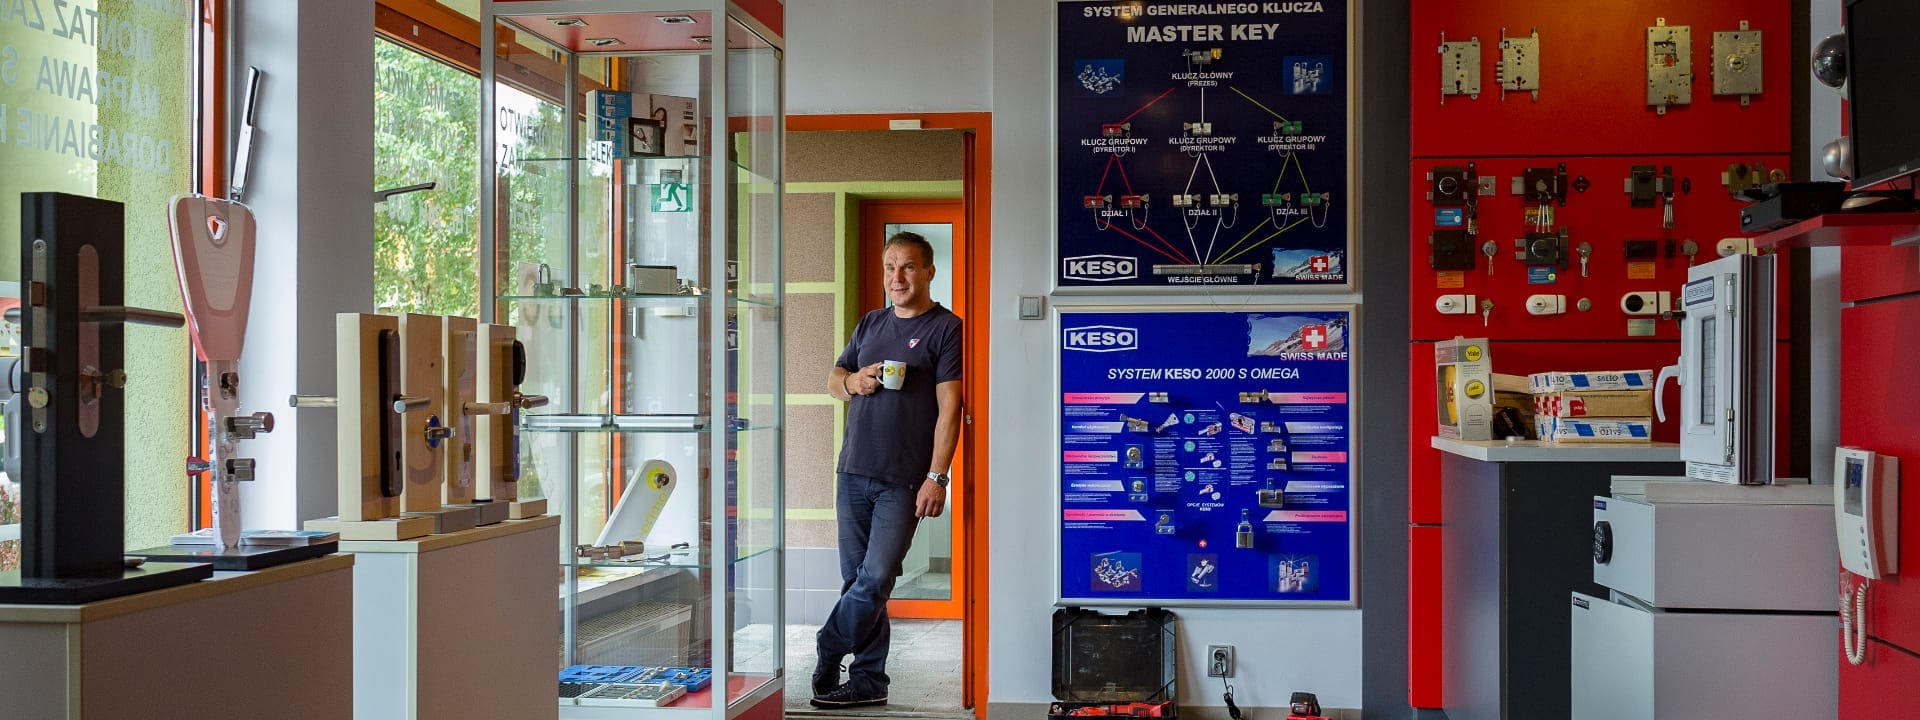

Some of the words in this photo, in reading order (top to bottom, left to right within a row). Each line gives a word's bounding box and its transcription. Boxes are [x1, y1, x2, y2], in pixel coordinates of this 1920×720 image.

[1083, 5, 1143, 17] SYSTEM
[1147, 3, 1259, 16] GENERALNEGO
[1262, 2, 1323, 14] KLUCZA
[1127, 25, 1223, 43] MASTER
[1231, 23, 1279, 41] KEY
[1171, 72, 1197, 80] KLUCZ
[1198, 71, 1233, 80] GŁÓWNY
[1187, 80, 1218, 88] (PREZES)
[1081, 138, 1107, 147] KLUCZ
[1108, 138, 1148, 146] GRUPOWY
[1168, 137, 1195, 145] KLUCZ
[1257, 136, 1283, 144] KLUCZ
[1285, 135, 1326, 143] GRUPOWY
[1069, 260, 1133, 276] KESO
[1167, 275, 1202, 284] WEJŚCIE
[1204, 275, 1238, 283] GŁÓWNE
[1069, 331, 1134, 346] KESO
[1280, 352, 1314, 361] SWISS
[1316, 352, 1348, 361] MADE
[1107, 368, 1162, 380] SYSTEM
[1164, 368, 1202, 380] KESO
[1205, 368, 1235, 380] 2000
[1238, 368, 1248, 379] S
[1250, 367, 1300, 380] OMEGA
[1597, 374, 1619, 382] SALTO
